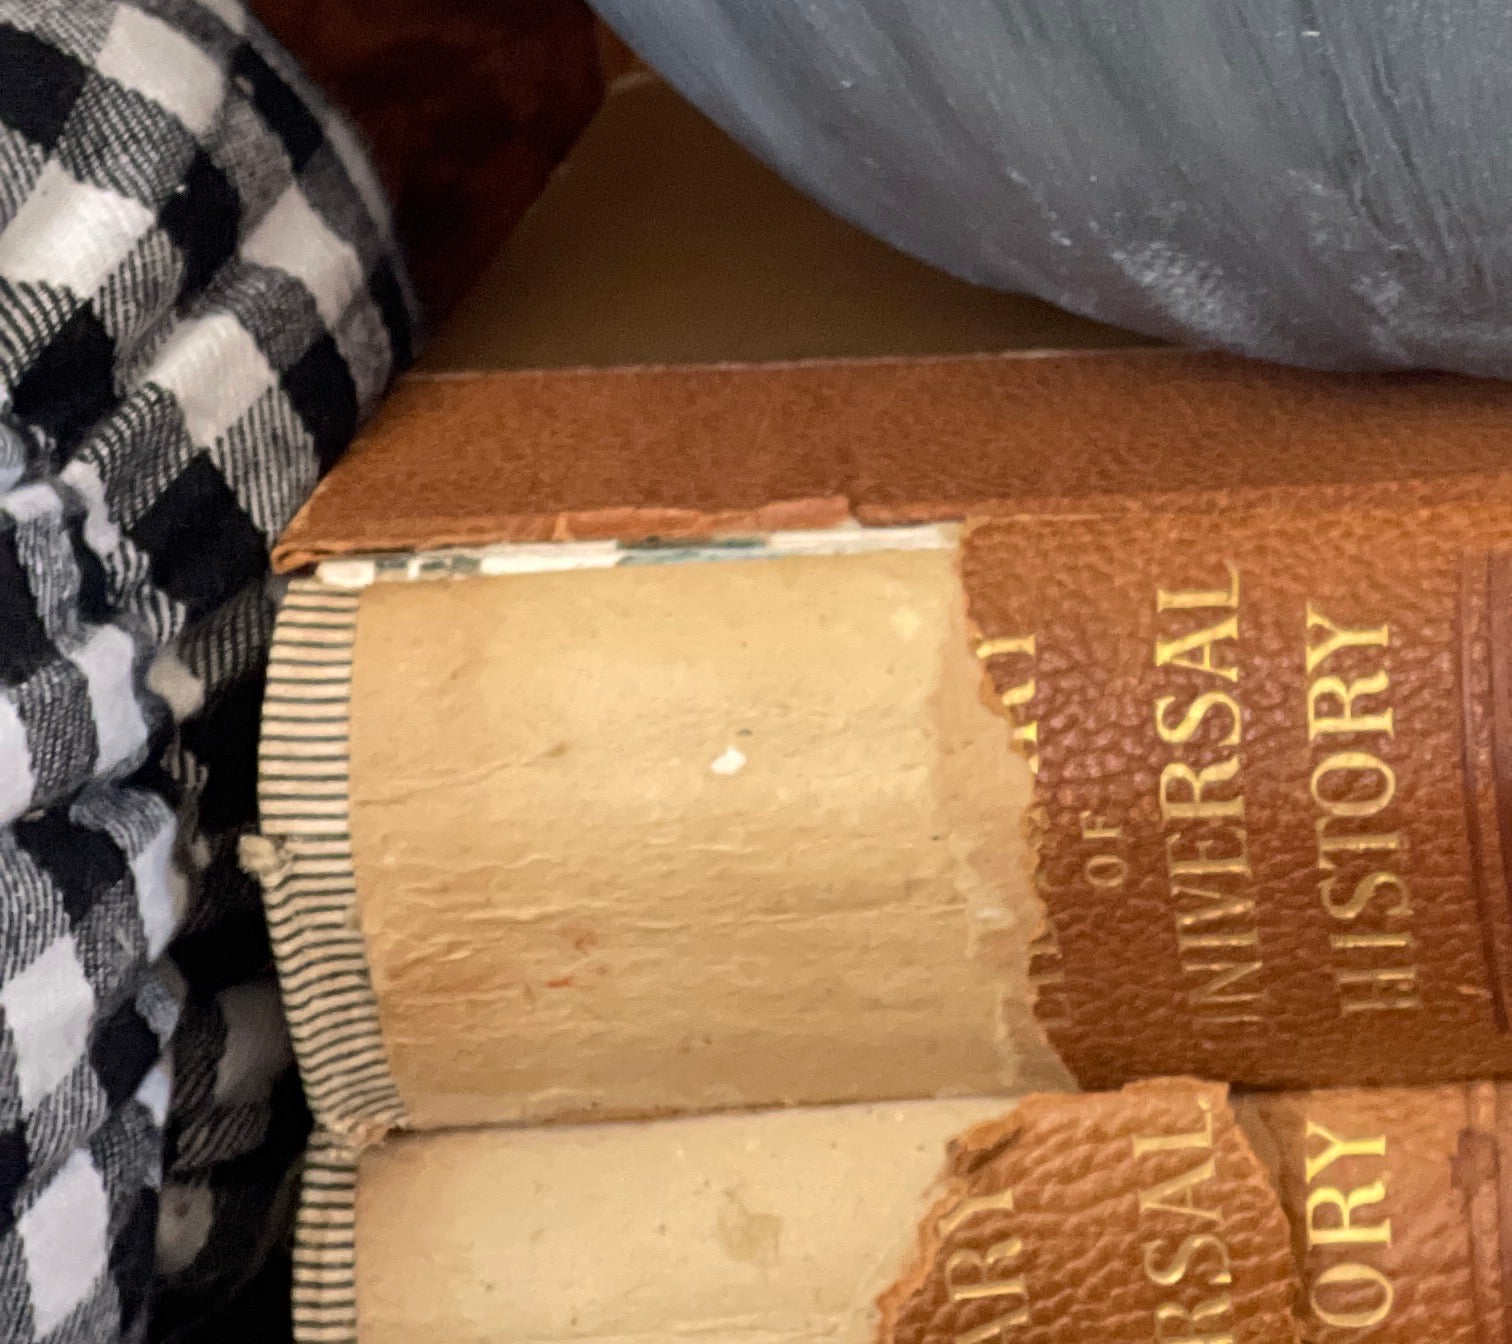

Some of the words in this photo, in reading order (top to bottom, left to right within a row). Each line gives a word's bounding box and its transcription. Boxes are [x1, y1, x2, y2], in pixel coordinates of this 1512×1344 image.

[1078, 810, 1130, 889] OF
[1305, 602, 1424, 1018] HISTORY
[1304, 1118, 1396, 1329] ORY
